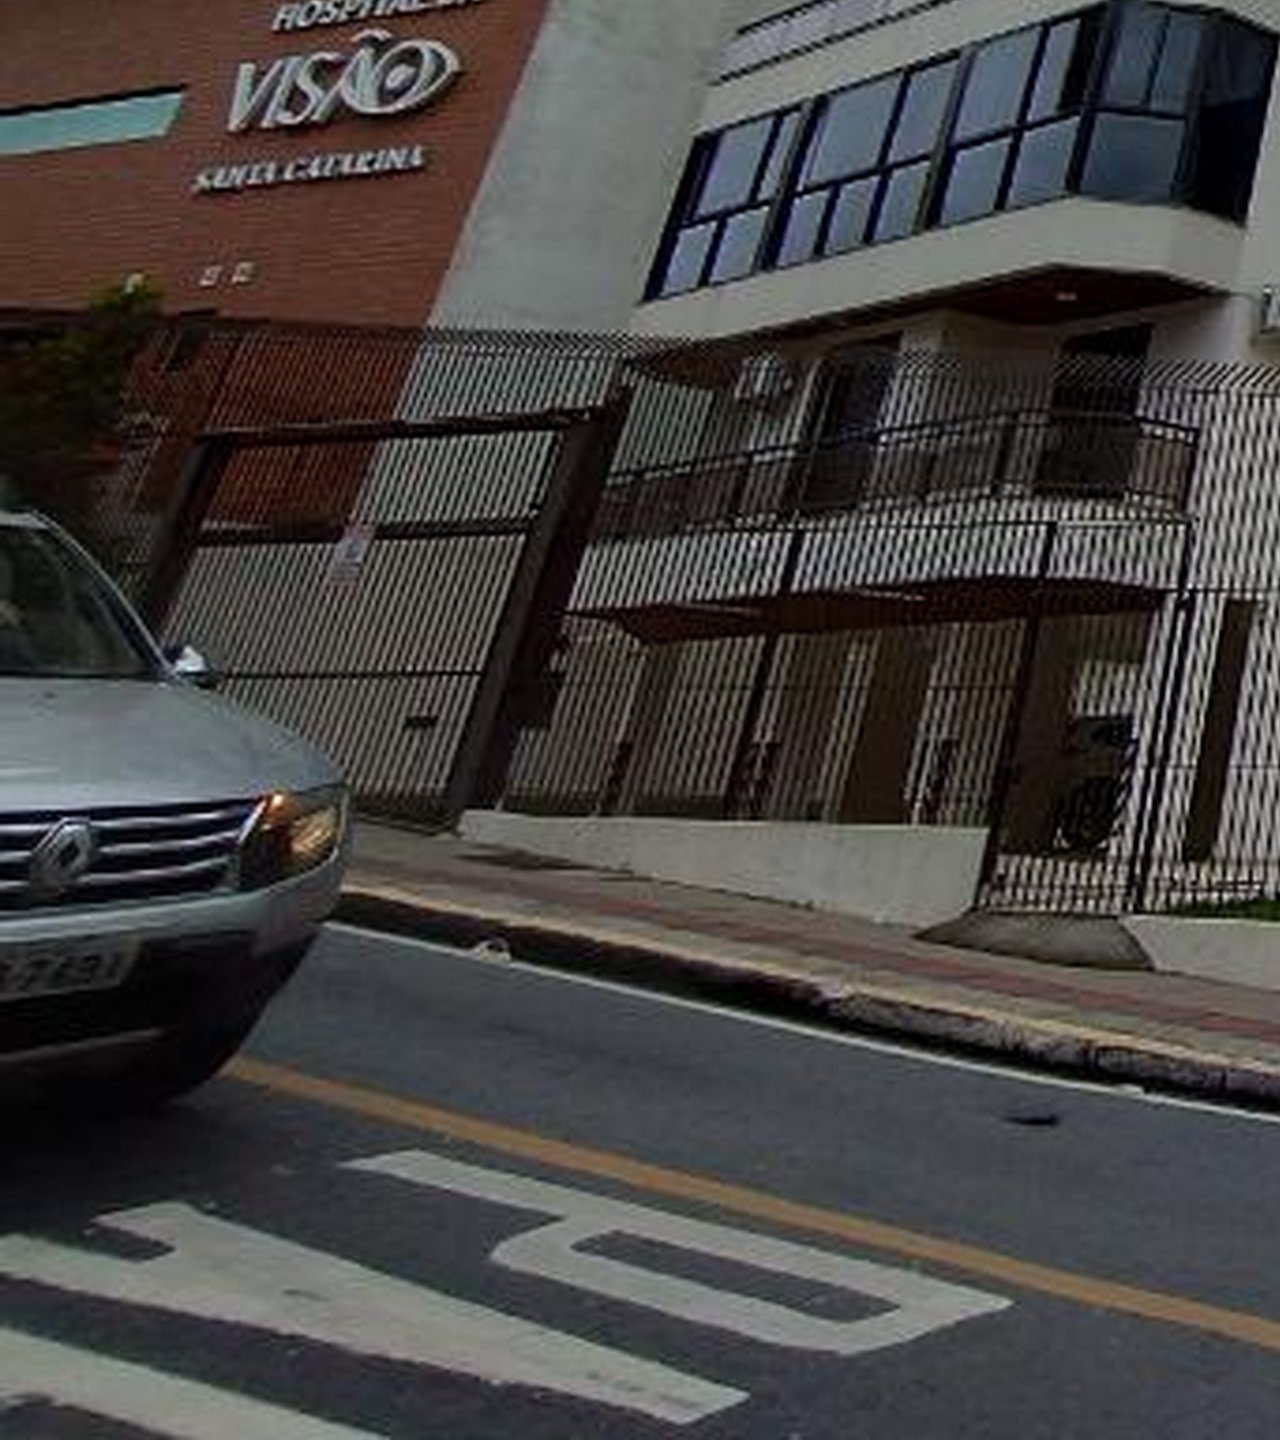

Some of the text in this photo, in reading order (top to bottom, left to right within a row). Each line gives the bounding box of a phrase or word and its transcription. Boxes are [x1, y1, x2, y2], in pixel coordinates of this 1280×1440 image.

[226, 28, 461, 132] VISÃO
[191, 145, 425, 195] SANTA CATARINA
